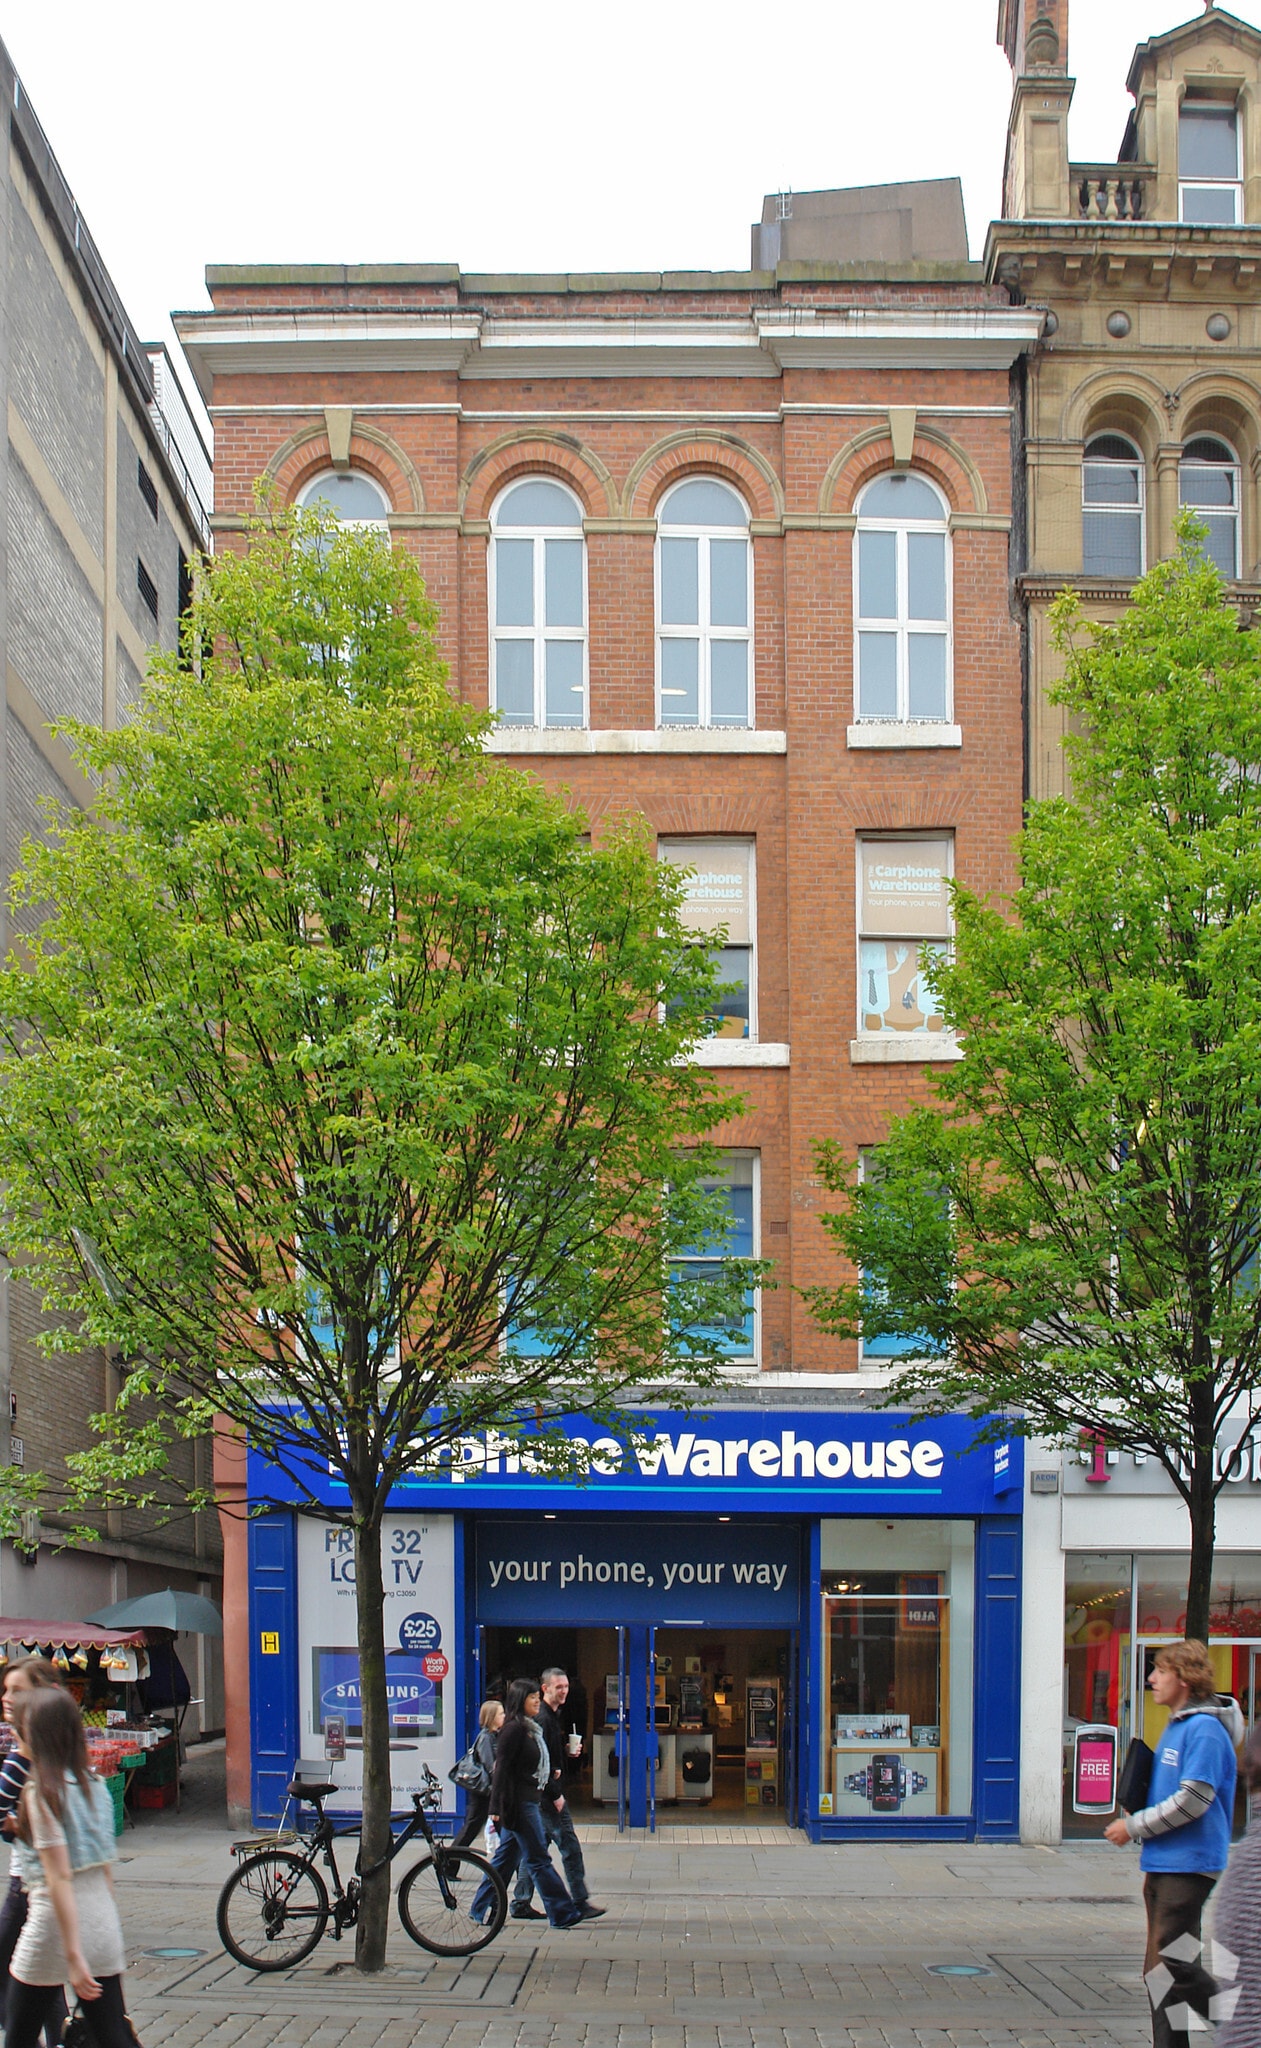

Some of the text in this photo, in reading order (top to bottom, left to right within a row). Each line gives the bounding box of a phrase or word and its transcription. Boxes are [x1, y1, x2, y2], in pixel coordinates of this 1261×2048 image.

[875, 864, 941, 879] Carphone
[868, 879, 941, 892] Warehouse
[362, 1428, 625, 1483] arphone
[631, 1430, 944, 1478] Warehouse
[325, 1528, 354, 1553] FR
[391, 1560, 424, 1584] TV
[489, 1554, 788, 1592] your phone, your way
[404, 1619, 437, 1638] £25
[264, 1634, 277, 1652] H
[425, 1657, 446, 1665] Worth
[336, 1684, 419, 1699] SAUNG
[1080, 1763, 1110, 1776] FREE
